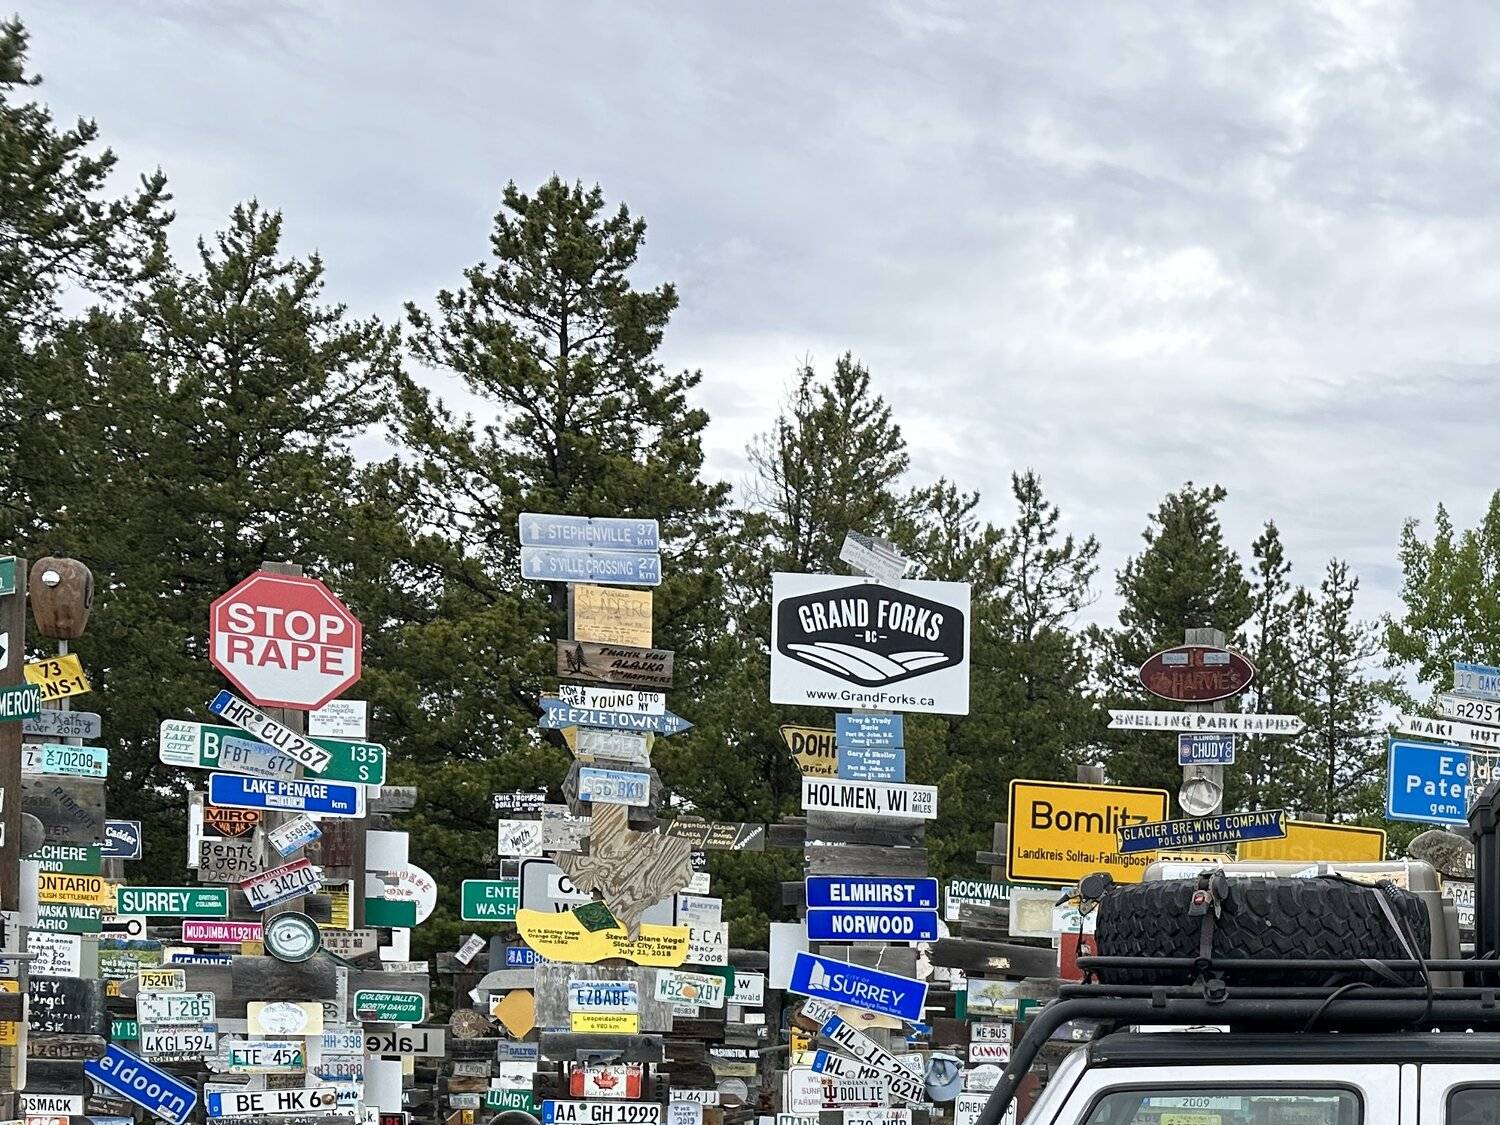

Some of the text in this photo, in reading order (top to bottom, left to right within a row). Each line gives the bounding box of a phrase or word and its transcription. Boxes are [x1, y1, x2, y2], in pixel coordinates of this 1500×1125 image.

[549, 524, 653, 543] STEPHENVILLE 37
[638, 537, 653, 546] km
[586, 560, 632, 576] CROSSING
[639, 558, 655, 569] 27
[639, 570, 655, 579] km
[227, 602, 345, 643] STOP
[798, 599, 944, 641] GRAND FORKS
[227, 635, 345, 676] RAPE
[39, 662, 61, 678] 73
[591, 694, 634, 708] YOUNG
[638, 691, 658, 702] OTTO
[638, 702, 649, 711] NY
[806, 689, 935, 707] www.GrandForks.ca
[549, 707, 659, 729] KEEZLETOWN
[1115, 714, 1300, 729] SNELLING PARK RAPIDS
[224, 700, 329, 771] HR CU 267
[1411, 721, 1453, 735] MAKI
[224, 745, 294, 774] FBT 672
[351, 746, 379, 763] 135
[359, 766, 368, 780] S
[243, 779, 328, 799] LAKE PENAGE
[331, 801, 347, 809] km
[808, 784, 931, 813] HOLMEN, WI 2320
[206, 809, 259, 821] MIRO
[1430, 802, 1460, 815] gem.
[1124, 813, 1277, 841] GLACIER BREWING COMPANY
[1018, 848, 1063, 862] Landkreis
[830, 883, 915, 903] ELMHIRST
[122, 892, 190, 912] SURREY
[70, 906, 101, 919] VALLEY
[186, 924, 228, 939] MUDJIMBA
[832, 915, 914, 933] NORWOOD
[831, 974, 905, 1006] SURREY
[146, 1036, 212, 1052] 4KGL594
[236, 1090, 304, 1111] BE HK
[841, 1087, 883, 1101] DOLLIE
[555, 1106, 659, 1123] AA GH 1999
